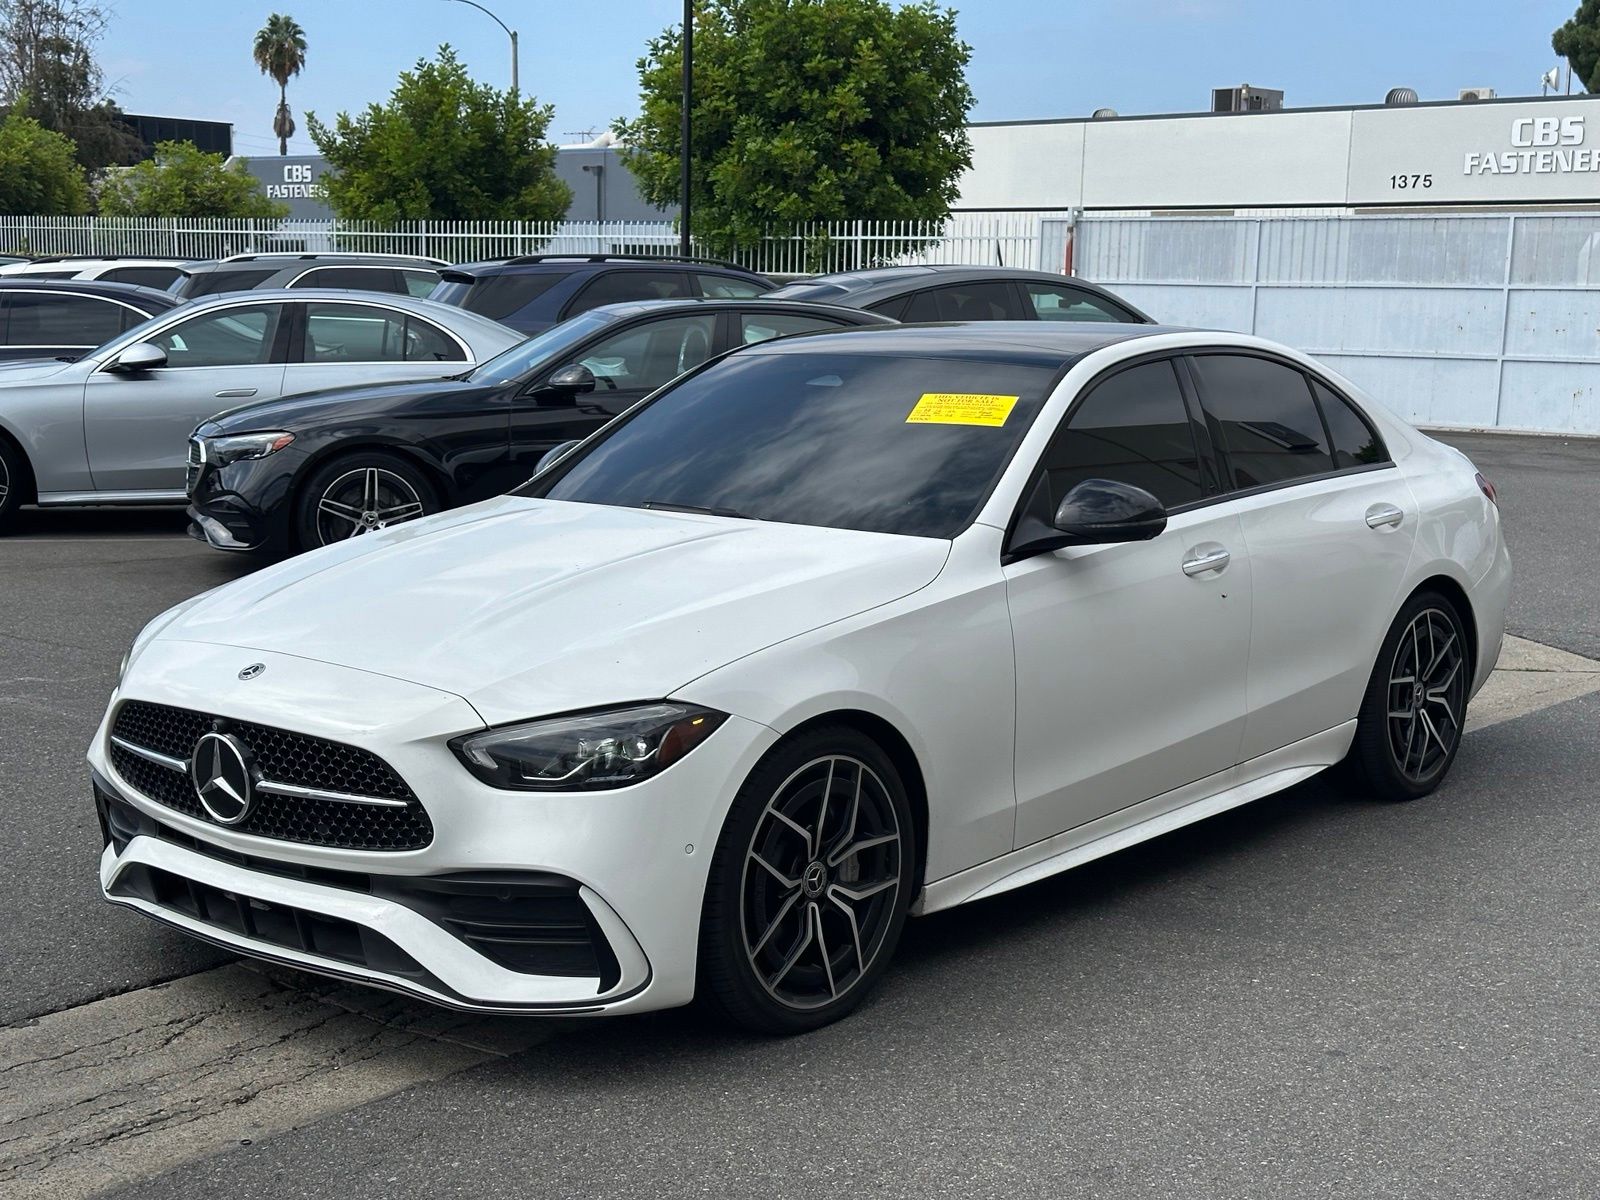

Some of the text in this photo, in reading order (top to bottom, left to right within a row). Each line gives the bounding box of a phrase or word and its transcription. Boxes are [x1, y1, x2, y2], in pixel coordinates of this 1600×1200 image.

[1511, 115, 1585, 147] CBS
[283, 164, 312, 183] CBS
[1390, 174, 1433, 189] 1375
